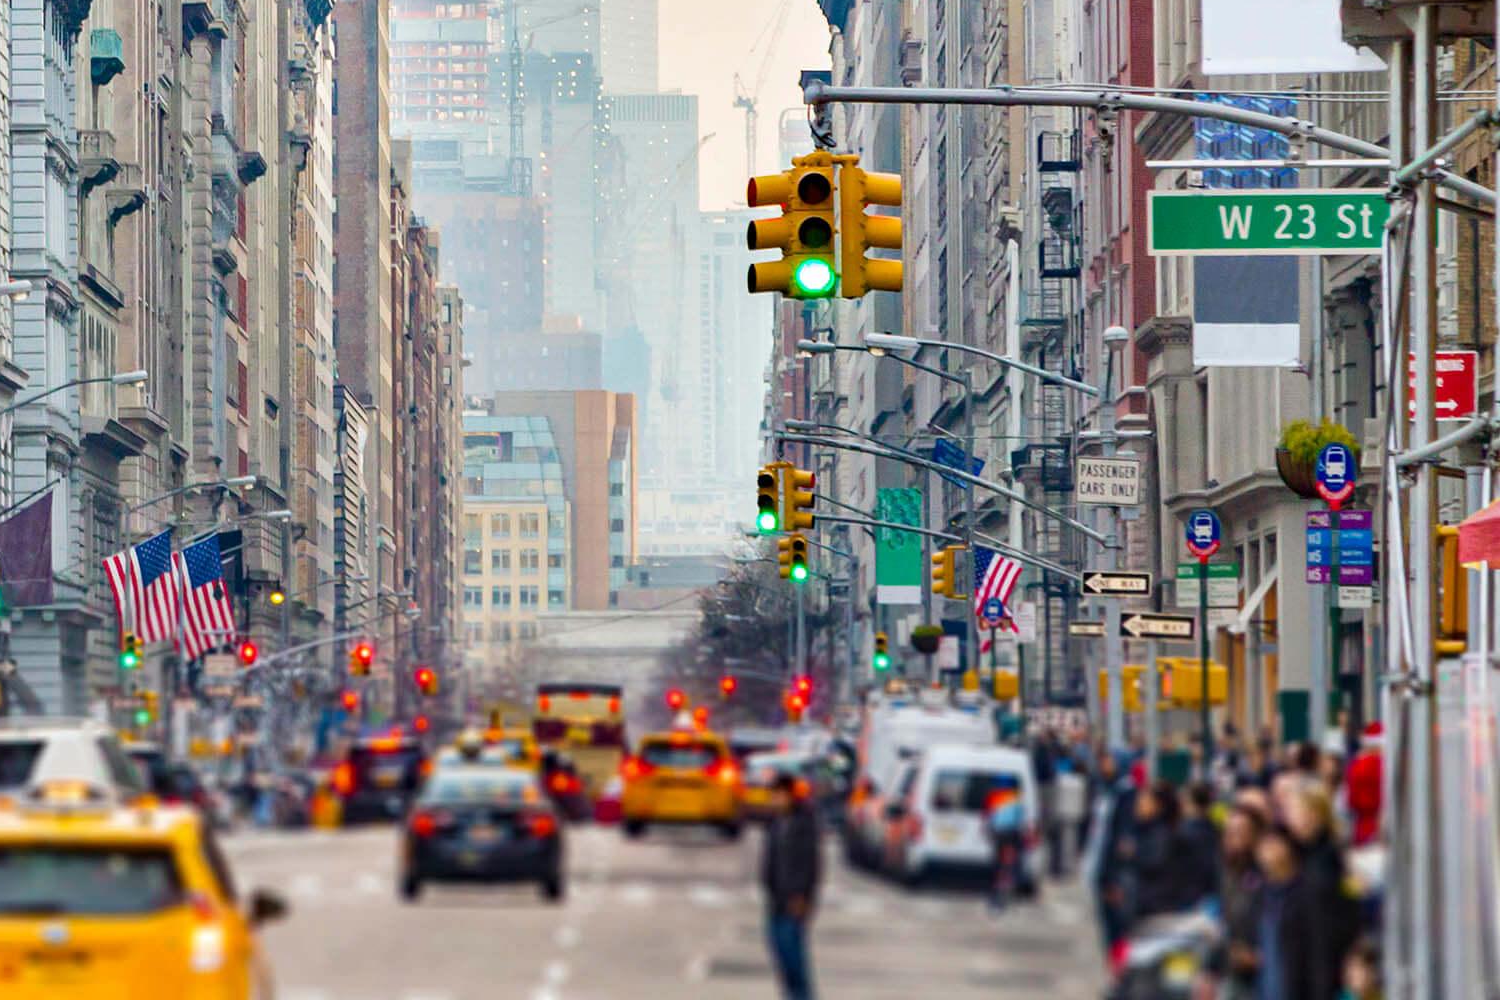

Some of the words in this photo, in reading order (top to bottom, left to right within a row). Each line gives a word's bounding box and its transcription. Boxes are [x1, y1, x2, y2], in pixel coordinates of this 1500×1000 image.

[1218, 204, 1253, 240] W
[1273, 203, 1317, 240] 23
[1336, 203, 1374, 239] St
[1080, 463, 1137, 479] PASSENGER
[1079, 481, 1106, 496] CARS
[1111, 483, 1136, 498] ONLY
[1091, 578, 1109, 588] ONE
[1120, 580, 1141, 588] WAY
[1130, 620, 1150, 631] ONE
[1162, 622, 1185, 632] WAY
